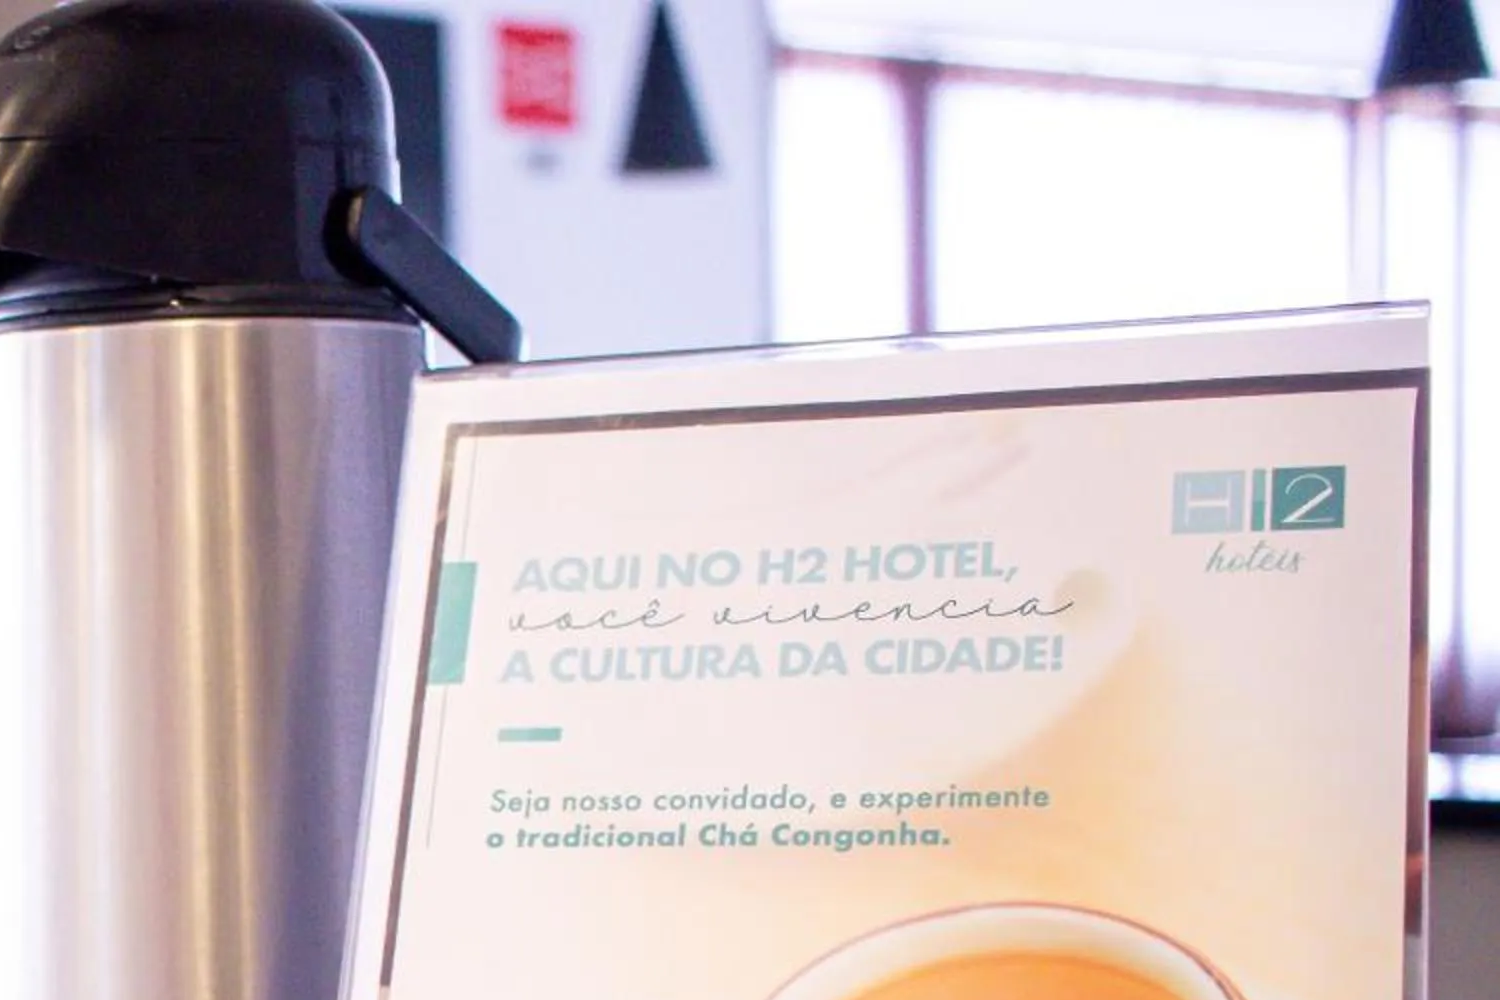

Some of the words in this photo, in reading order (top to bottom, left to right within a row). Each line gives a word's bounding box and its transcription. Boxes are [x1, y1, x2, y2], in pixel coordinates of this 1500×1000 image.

[512, 554, 640, 592] AQUI
[656, 550, 741, 588] NO
[758, 547, 828, 585] H2
[843, 541, 1018, 583] HOTEL,
[1204, 540, 1305, 573] hoteis
[508, 599, 685, 631] você
[713, 597, 1074, 626] vivencia
[501, 649, 534, 683] A
[549, 644, 761, 682] CULTURA
[778, 640, 848, 677] DA
[864, 635, 1064, 675] CIDADE!
[490, 788, 550, 818] Seja
[562, 794, 642, 811] nosso
[653, 784, 815, 814] convidado,
[830, 792, 847, 809] e
[859, 785, 1051, 815] experimente
[486, 832, 504, 848] o
[516, 823, 686, 848] tradicional
[698, 822, 758, 846] Chá
[772, 821, 951, 852] Congonha.
